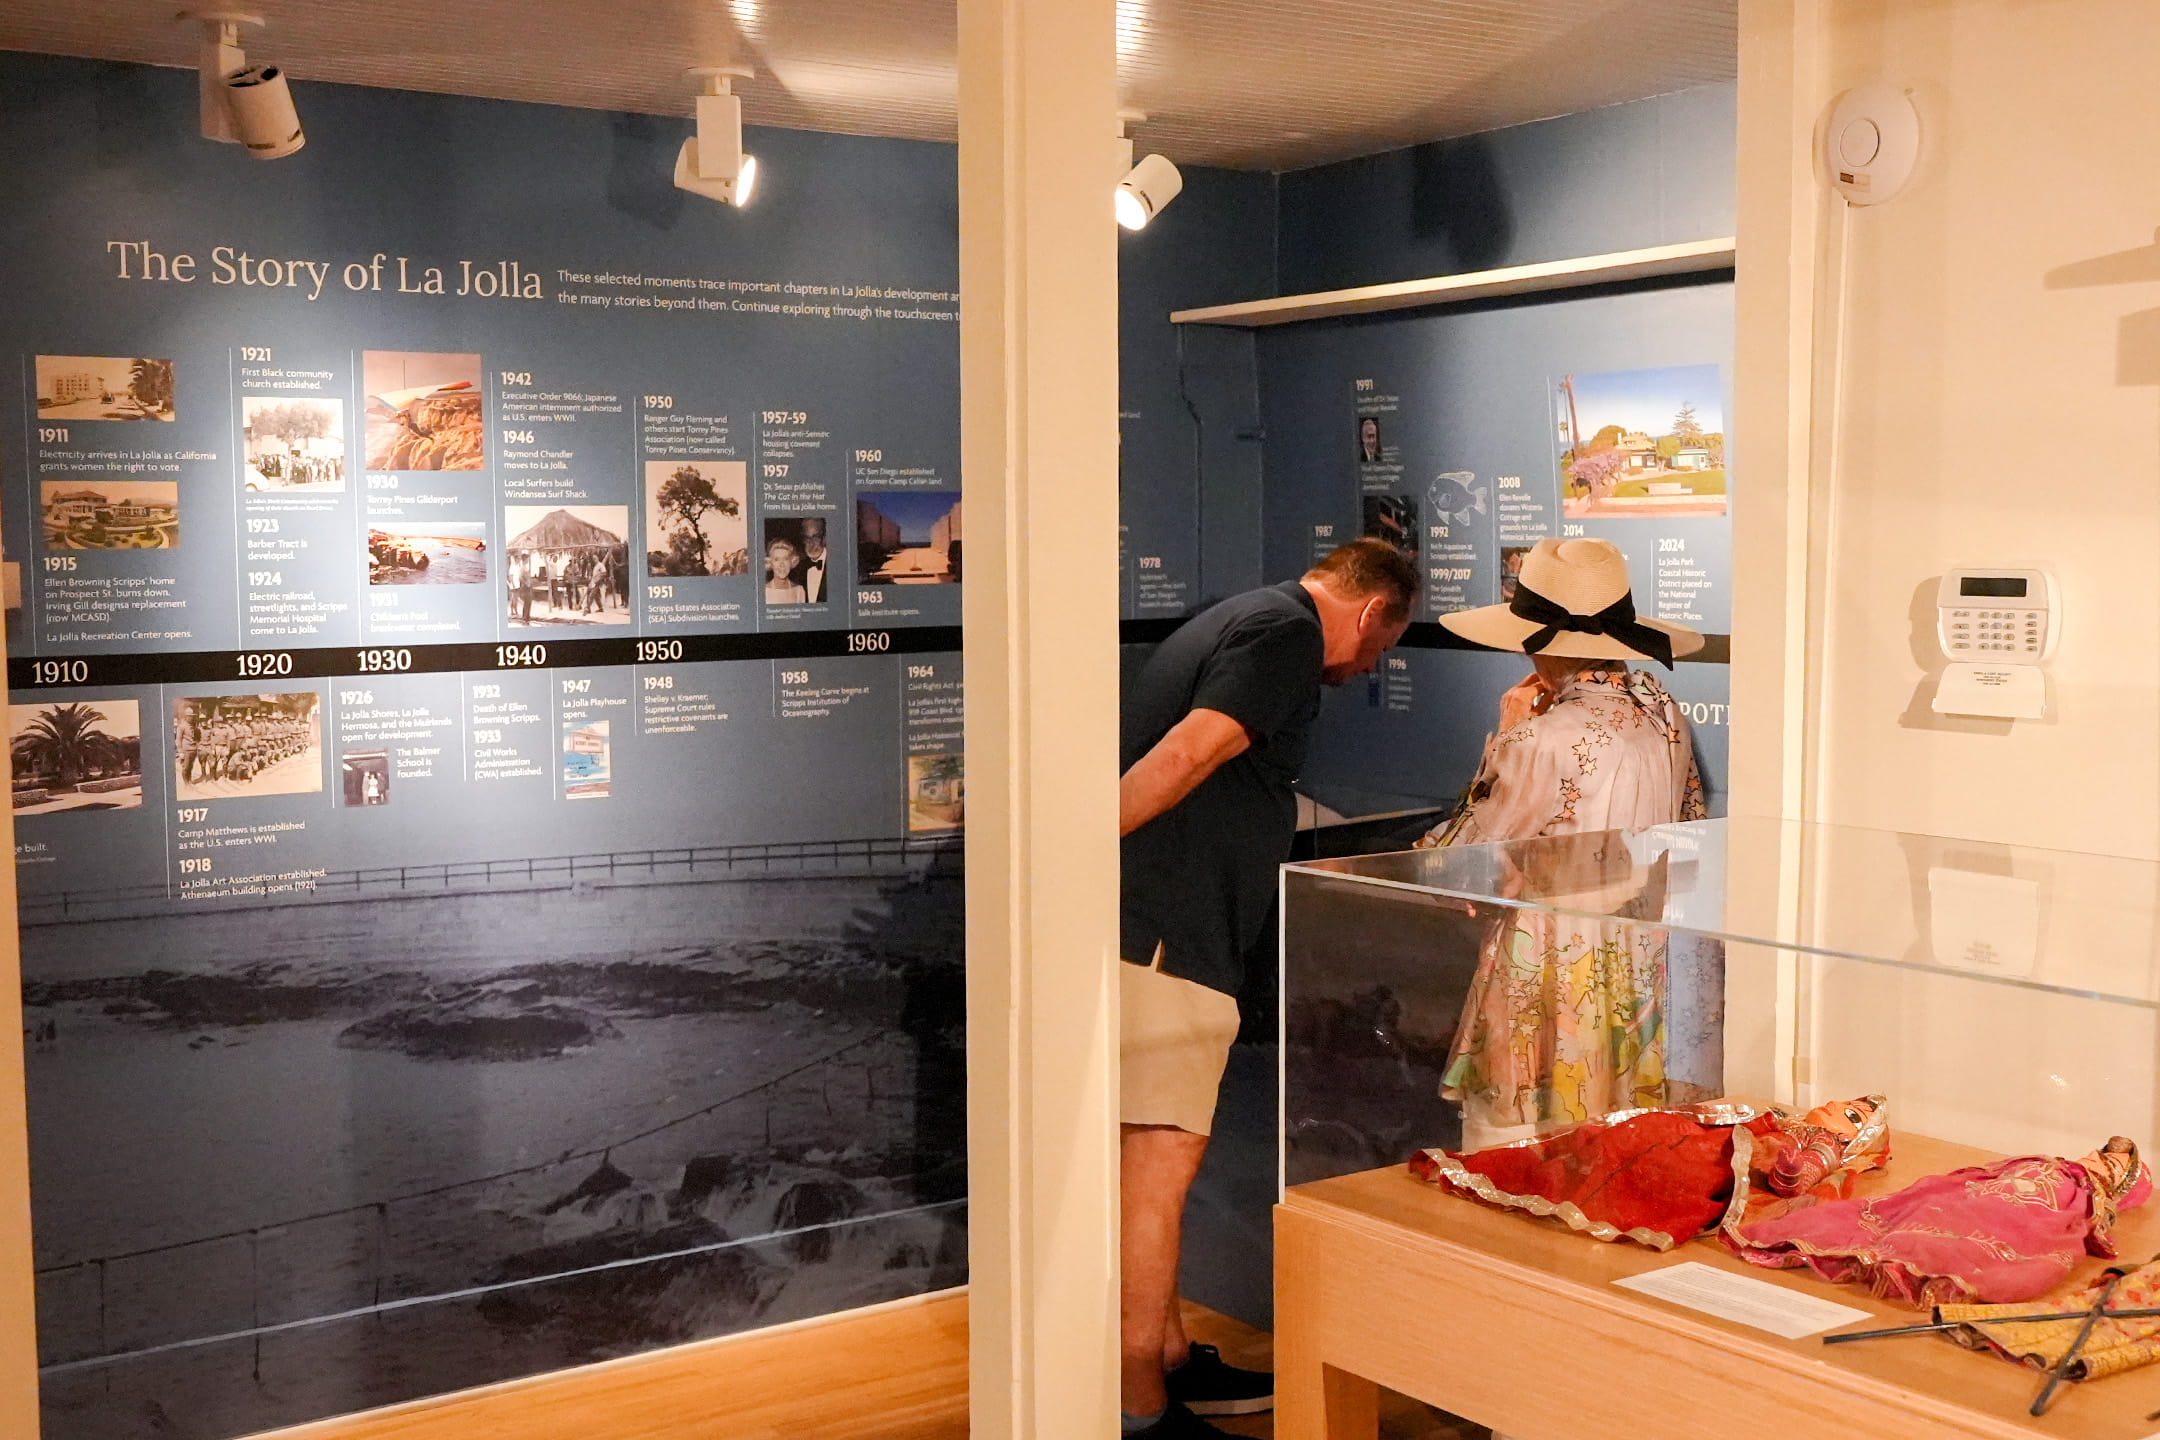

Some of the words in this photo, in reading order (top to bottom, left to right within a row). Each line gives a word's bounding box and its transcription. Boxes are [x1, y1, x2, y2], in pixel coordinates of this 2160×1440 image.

[107, 240, 197, 282] The
[211, 246, 331, 301] Story
[343, 253, 386, 292] of
[397, 256, 445, 296] La
[456, 259, 544, 300] Jolla
[557, 270, 592, 284] These
[594, 272, 641, 286] selected
[644, 274, 697, 288] moments
[698, 277, 725, 290] trace
[728, 278, 781, 295] important
[783, 281, 829, 297] chapters
[830, 283, 840, 295] in
[842, 283, 854, 296] La
[855, 284, 882, 300] Jolla's
[884, 285, 949, 303] development
[558, 291, 577, 304] the
[580, 295, 612, 308] many
[614, 294, 651, 307] stories
[654, 295, 696, 312] beyond
[697, 297, 729, 310] them.
[731, 299, 780, 312] Continue
[782, 301, 830, 318] exploring
[833, 303, 873, 319] through
[874, 305, 891, 317] the
[894, 306, 952, 320] touchscreen
[240, 346, 272, 362] 1921
[241, 368, 260, 376] First
[262, 369, 284, 377] Black
[286, 369, 334, 380] community
[500, 372, 532, 386] 1942
[643, 395, 672, 409] 1950
[644, 414, 668, 424] Ranger
[670, 415, 685, 424] Guy
[686, 415, 713, 425] Fleming
[762, 411, 807, 424] 1957-59
[38, 428, 68, 443] 1911
[670, 425, 685, 433] start
[687, 425, 709, 435] Torrey
[503, 430, 534, 444] 1946
[39, 450, 86, 461] Electricity
[88, 450, 118, 459] arrives
[120, 451, 129, 459] in
[130, 451, 141, 459] La
[141, 451, 162, 462] Jolla
[175, 452, 217, 460] California
[504, 450, 539, 460] Raymond
[540, 450, 574, 459] Chandler
[855, 449, 882, 463] 1960
[39, 463, 68, 473] grants
[106, 463, 122, 471] the
[124, 463, 146, 473] right
[147, 463, 158, 471] to
[159, 463, 182, 472] vote.
[763, 464, 789, 477] 1957
[366, 475, 398, 489] 1930
[504, 479, 525, 487] Local
[526, 479, 553, 487] Surfers
[555, 479, 574, 487] build
[1498, 476, 1520, 488] 2008
[246, 519, 280, 533] 1923
[1430, 526, 1448, 538] 1992
[1563, 524, 1584, 536] 2014
[247, 540, 276, 549] Barber
[278, 539, 300, 548] Tract
[301, 539, 307, 548] is
[1659, 538, 1685, 552] 2024
[44, 556, 78, 571] 1915
[1140, 557, 1161, 569] 1978
[1659, 558, 1666, 566] La
[1666, 558, 1680, 568] Jolla
[1681, 558, 1694, 566] Park
[44, 579, 66, 587] Ellen
[68, 578, 111, 588] Browning
[149, 577, 176, 585] home
[248, 572, 282, 586] 1924
[1659, 580, 1681, 588] District
[1682, 580, 1701, 590] placed
[648, 585, 673, 598] 1951
[857, 592, 882, 604] 1963
[648, 604, 674, 614] Scripps
[675, 604, 700, 612] Estates
[701, 603, 741, 611] Association
[250, 614, 291, 623] Memorial
[292, 614, 327, 624] Hospital
[47, 634, 57, 642] La
[60, 633, 79, 643] Jolla
[81, 632, 130, 641] Recreation
[131, 631, 161, 639] Center
[164, 632, 192, 640] opens.
[847, 632, 890, 652] 1960
[495, 644, 547, 666] 1940
[636, 640, 683, 662] 1950
[237, 653, 293, 676] 1920
[358, 649, 412, 671] 1930
[1388, 658, 1407, 670] 1996
[32, 660, 88, 684] 1910
[782, 670, 808, 684] 1958
[907, 666, 934, 678] 1964
[562, 680, 591, 694] 1947
[644, 676, 673, 690] 1948
[340, 690, 374, 704] 1926
[472, 685, 501, 699] 1932
[473, 704, 497, 713] Death
[499, 704, 507, 712] of
[509, 703, 528, 712] Ellen
[563, 700, 572, 708] La
[572, 699, 589, 709] Jolla
[590, 697, 627, 708] Playhouse
[645, 705, 675, 715] Supreme
[677, 704, 697, 712] Court
[698, 703, 716, 711] rules
[645, 715, 679, 723] restrictive
[681, 713, 716, 722] covenants
[474, 730, 501, 744] 1933
[474, 749, 491, 757] Civil
[493, 748, 517, 757] Works
[397, 758, 424, 767] School
[426, 758, 432, 766] is
[177, 808, 208, 823] 1917
[178, 829, 203, 840] Camp
[205, 826, 248, 836] Matthews
[250, 825, 256, 833] is
[258, 822, 305, 832] established
[190, 840, 204, 849] the
[206, 838, 223, 847] U.S.
[225, 836, 252, 846] enters
[179, 858, 212, 874] 1918
[180, 879, 190, 888] La
[191, 878, 210, 889] Jolla
[212, 877, 226, 886] Art
[228, 873, 276, 884] Association
